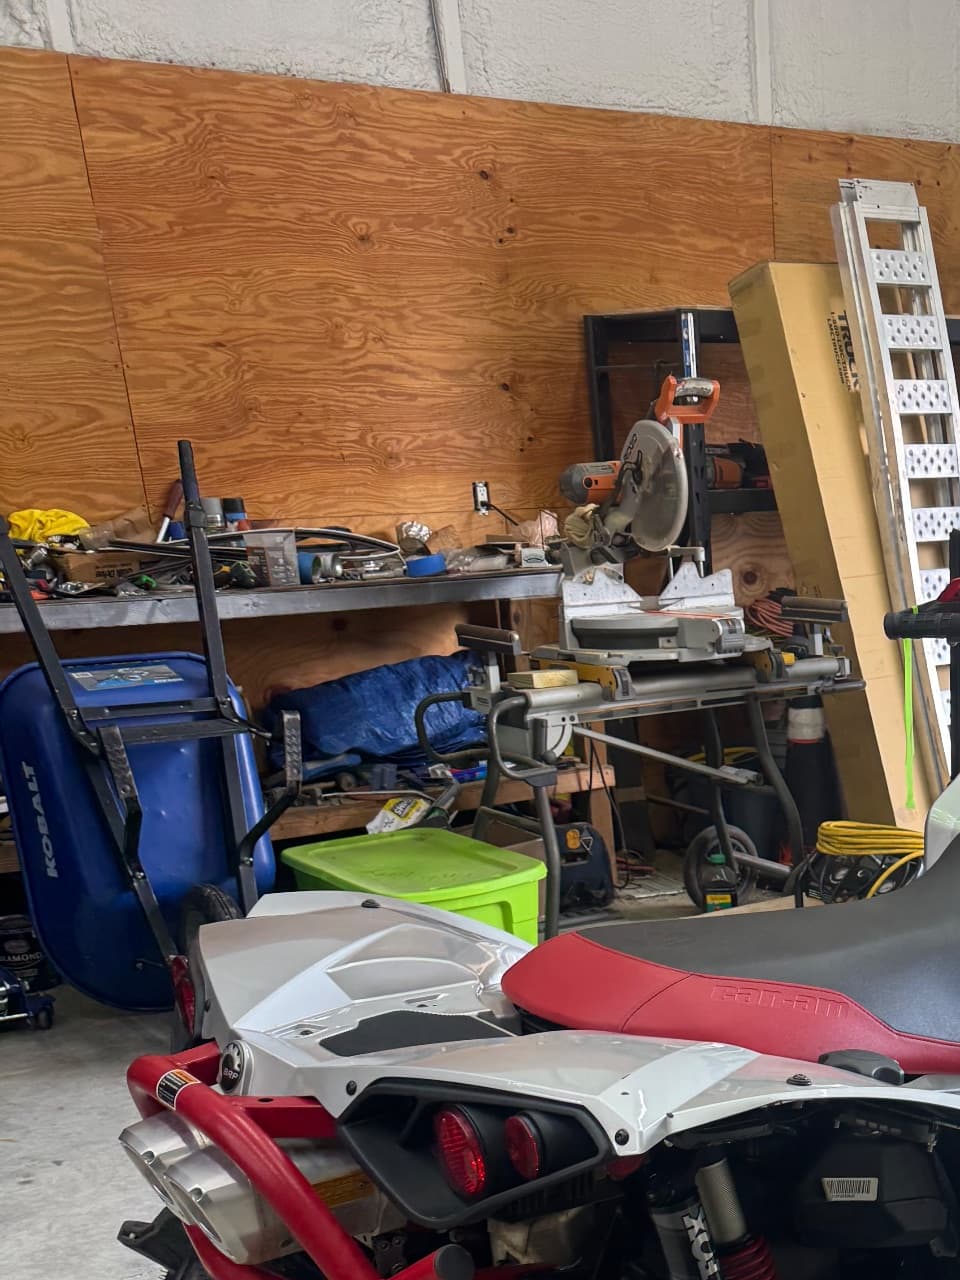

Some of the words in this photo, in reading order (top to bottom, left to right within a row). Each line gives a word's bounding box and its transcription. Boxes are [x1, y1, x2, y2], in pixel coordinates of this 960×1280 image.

[838, 309, 860, 391] TRUCK
[21, 760, 59, 878] KOBALT
[710, 984, 850, 1018] can-am
[223, 1067, 239, 1080] BRP
